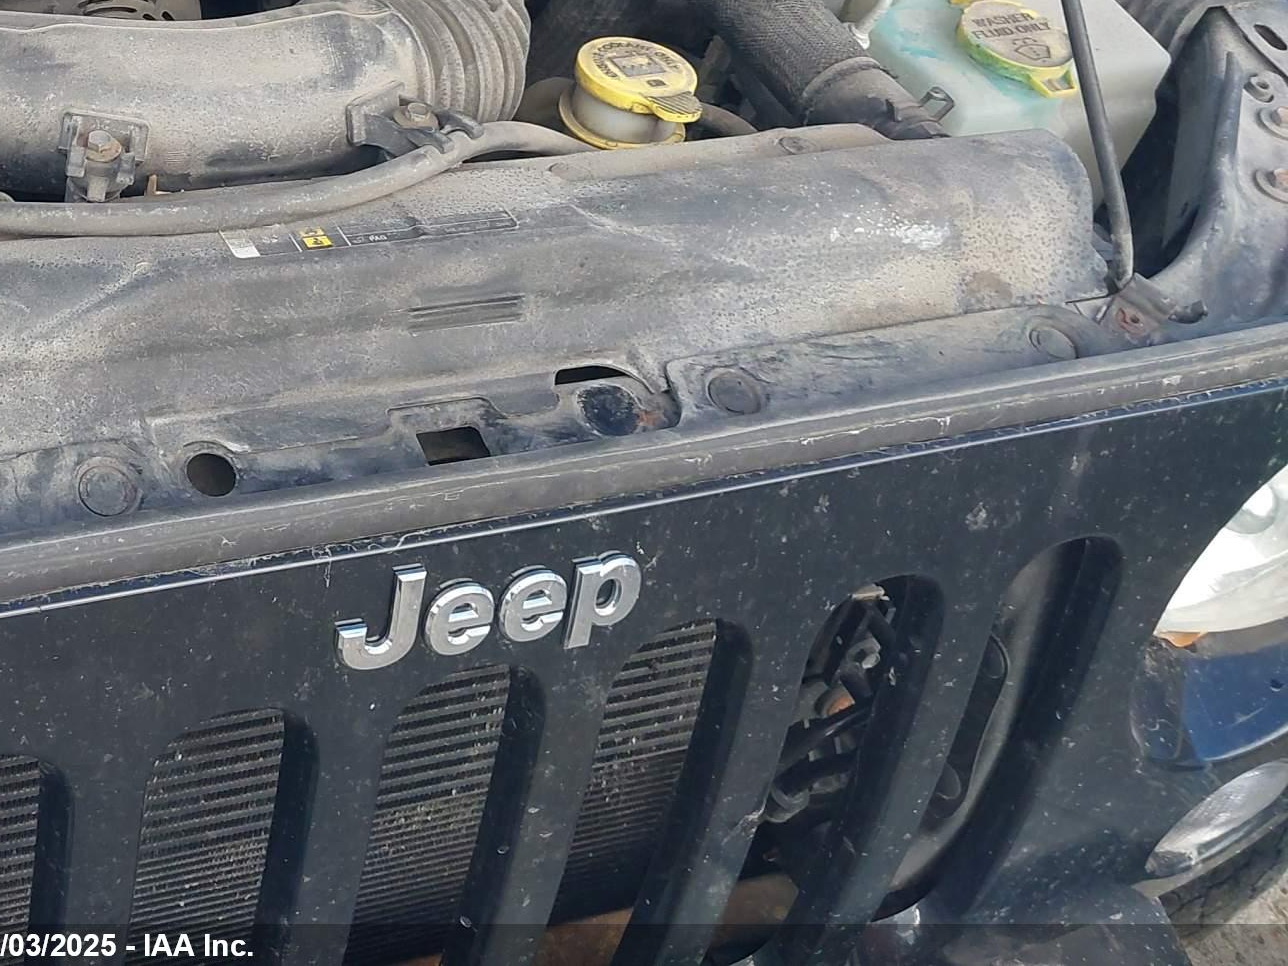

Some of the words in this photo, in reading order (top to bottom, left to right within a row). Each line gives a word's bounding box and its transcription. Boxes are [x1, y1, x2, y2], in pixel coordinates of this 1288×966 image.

[972, 12, 1034, 27] WASHER
[972, 27, 1013, 39] FLUID
[1014, 21, 1051, 34] ONLY
[334, 550, 642, 671] Jeep
